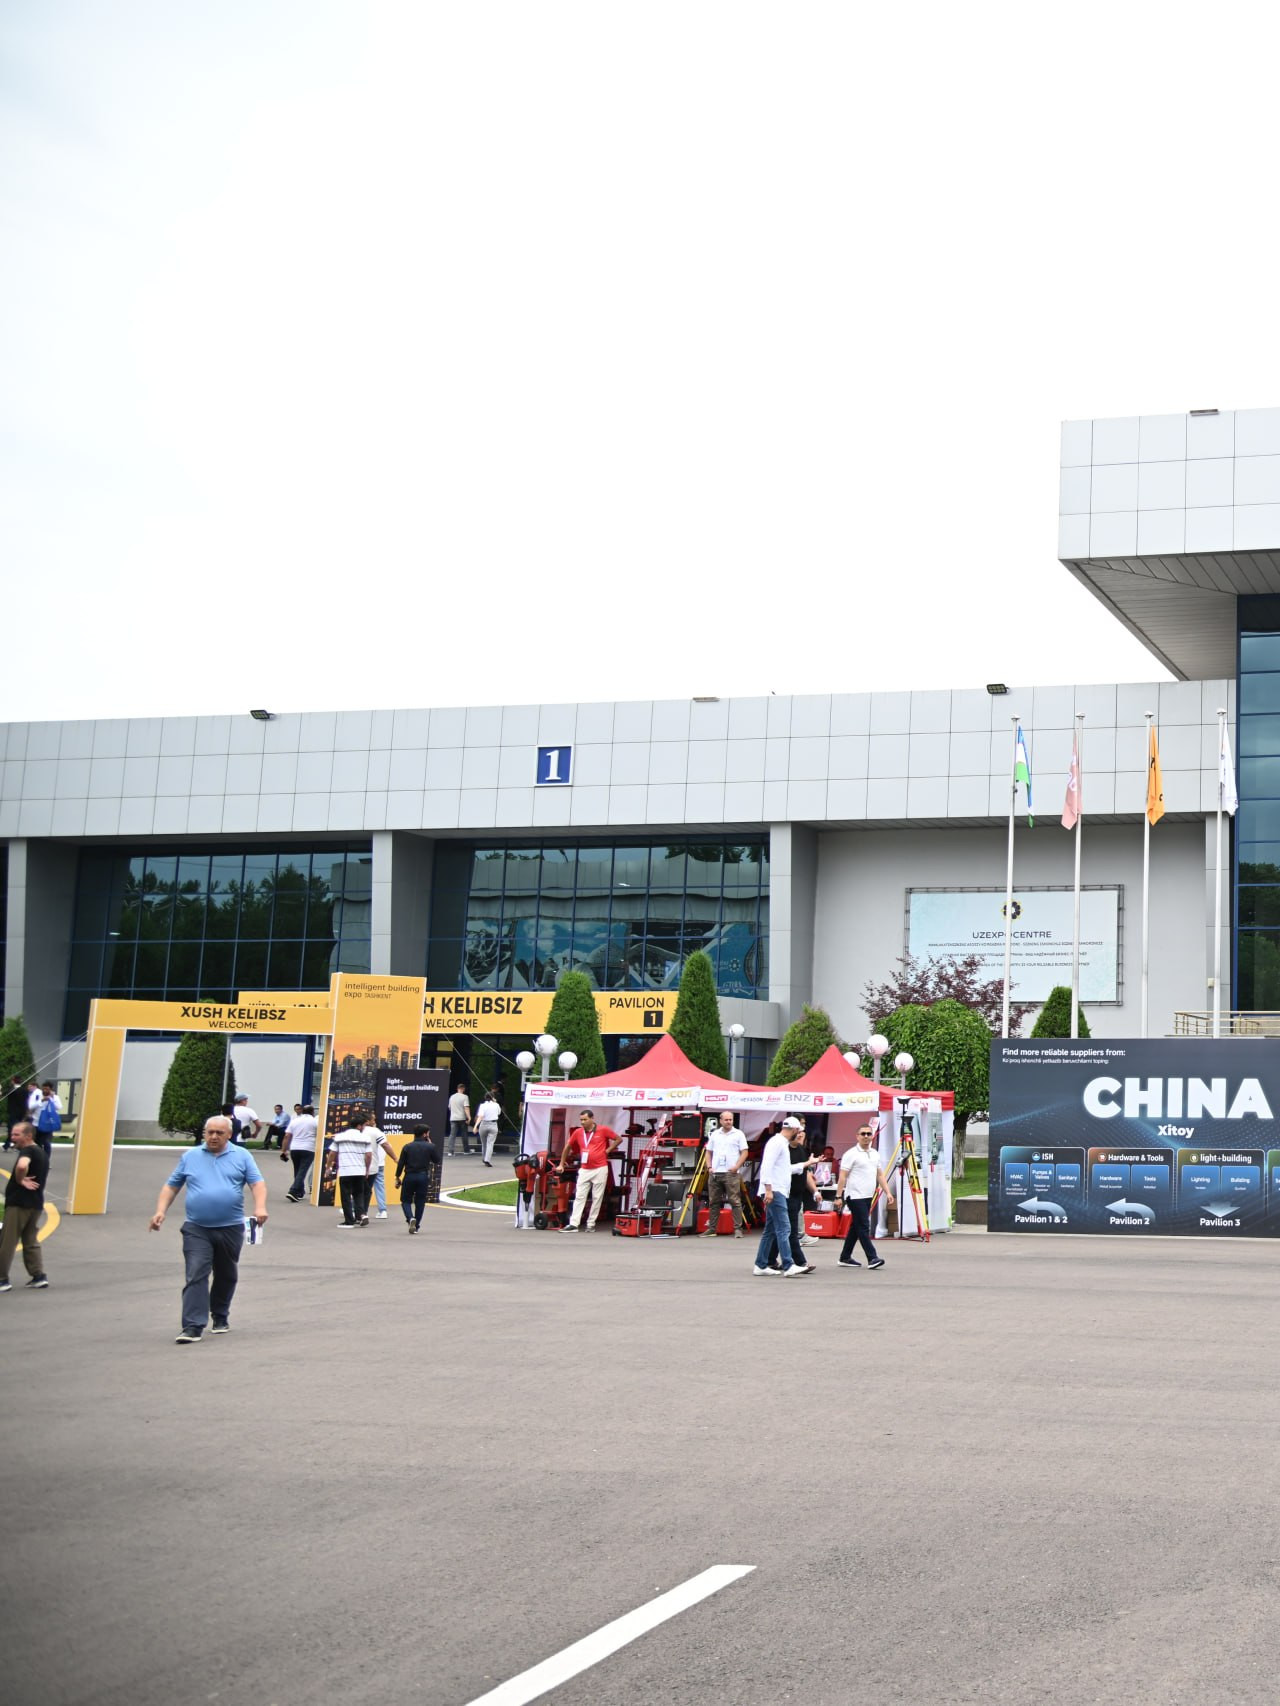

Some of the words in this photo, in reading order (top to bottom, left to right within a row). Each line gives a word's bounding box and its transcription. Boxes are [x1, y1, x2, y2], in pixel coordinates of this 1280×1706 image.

[545, 749, 562, 781] 1
[344, 982, 386, 993] intelligent
[387, 984, 420, 994] building
[344, 992, 362, 1000] expo
[441, 997, 523, 1015] KELIBSIZ
[609, 997, 665, 1009] PAVILION
[181, 1006, 222, 1018] XUSH
[227, 1008, 287, 1021] KELIBSZ
[650, 1012, 657, 1025] 1
[208, 1021, 258, 1030] WELCOME
[425, 1018, 478, 1029] WELCOME
[1002, 1048, 1019, 1056] Find
[1041, 1048, 1069, 1056] reliable
[1070, 1048, 1104, 1057] suppliers
[1105, 1048, 1126, 1056] from:
[416, 1084, 439, 1092] building
[607, 1089, 633, 1097] BNZ
[1083, 1076, 1274, 1119] CHINA
[384, 1095, 408, 1107] ISH
[784, 1094, 810, 1102] BNZ
[383, 1111, 423, 1120] intersec
[1158, 1124, 1194, 1138] Xitoy
[1147, 1154, 1164, 1162] Tools
[1200, 1154, 1252, 1164] light+building
[1015, 1214, 1047, 1223] Pavilion
[1110, 1216, 1143, 1225] Pavilion
[1144, 1217, 1150, 1225] 2
[1200, 1218, 1233, 1226] Pavilion
